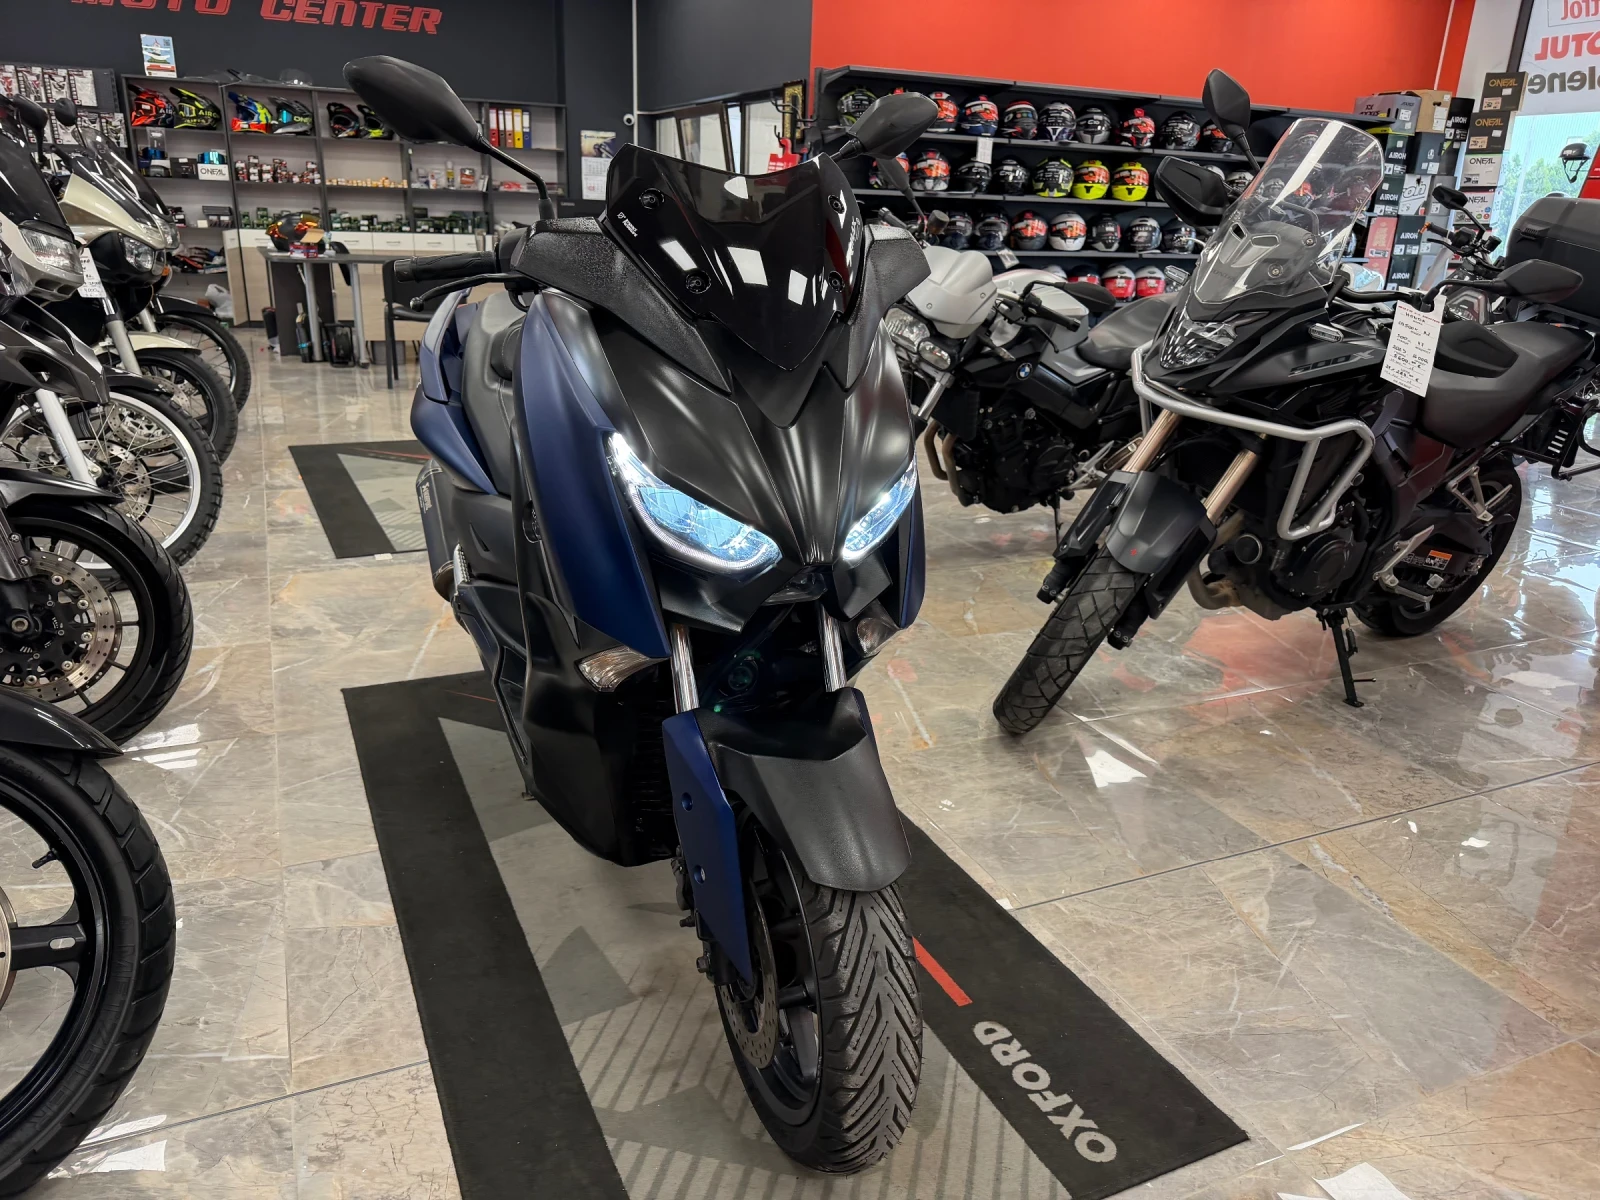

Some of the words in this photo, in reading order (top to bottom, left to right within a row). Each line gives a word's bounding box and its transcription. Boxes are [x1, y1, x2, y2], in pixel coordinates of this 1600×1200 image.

[260, 0, 442, 34] CENTER
[1489, 78, 1518, 87] ONEAL
[1450, 116, 1468, 124] AIROH
[1475, 118, 1503, 127] ONEAL
[1388, 152, 1407, 160] AIROH
[1469, 157, 1496, 165] ONEAL
[200, 167, 226, 177] ONEAL
[1380, 193, 1399, 201] AIROH
[1468, 196, 1488, 204] NEAL
[973, 1021, 1117, 1163] OXFORD
